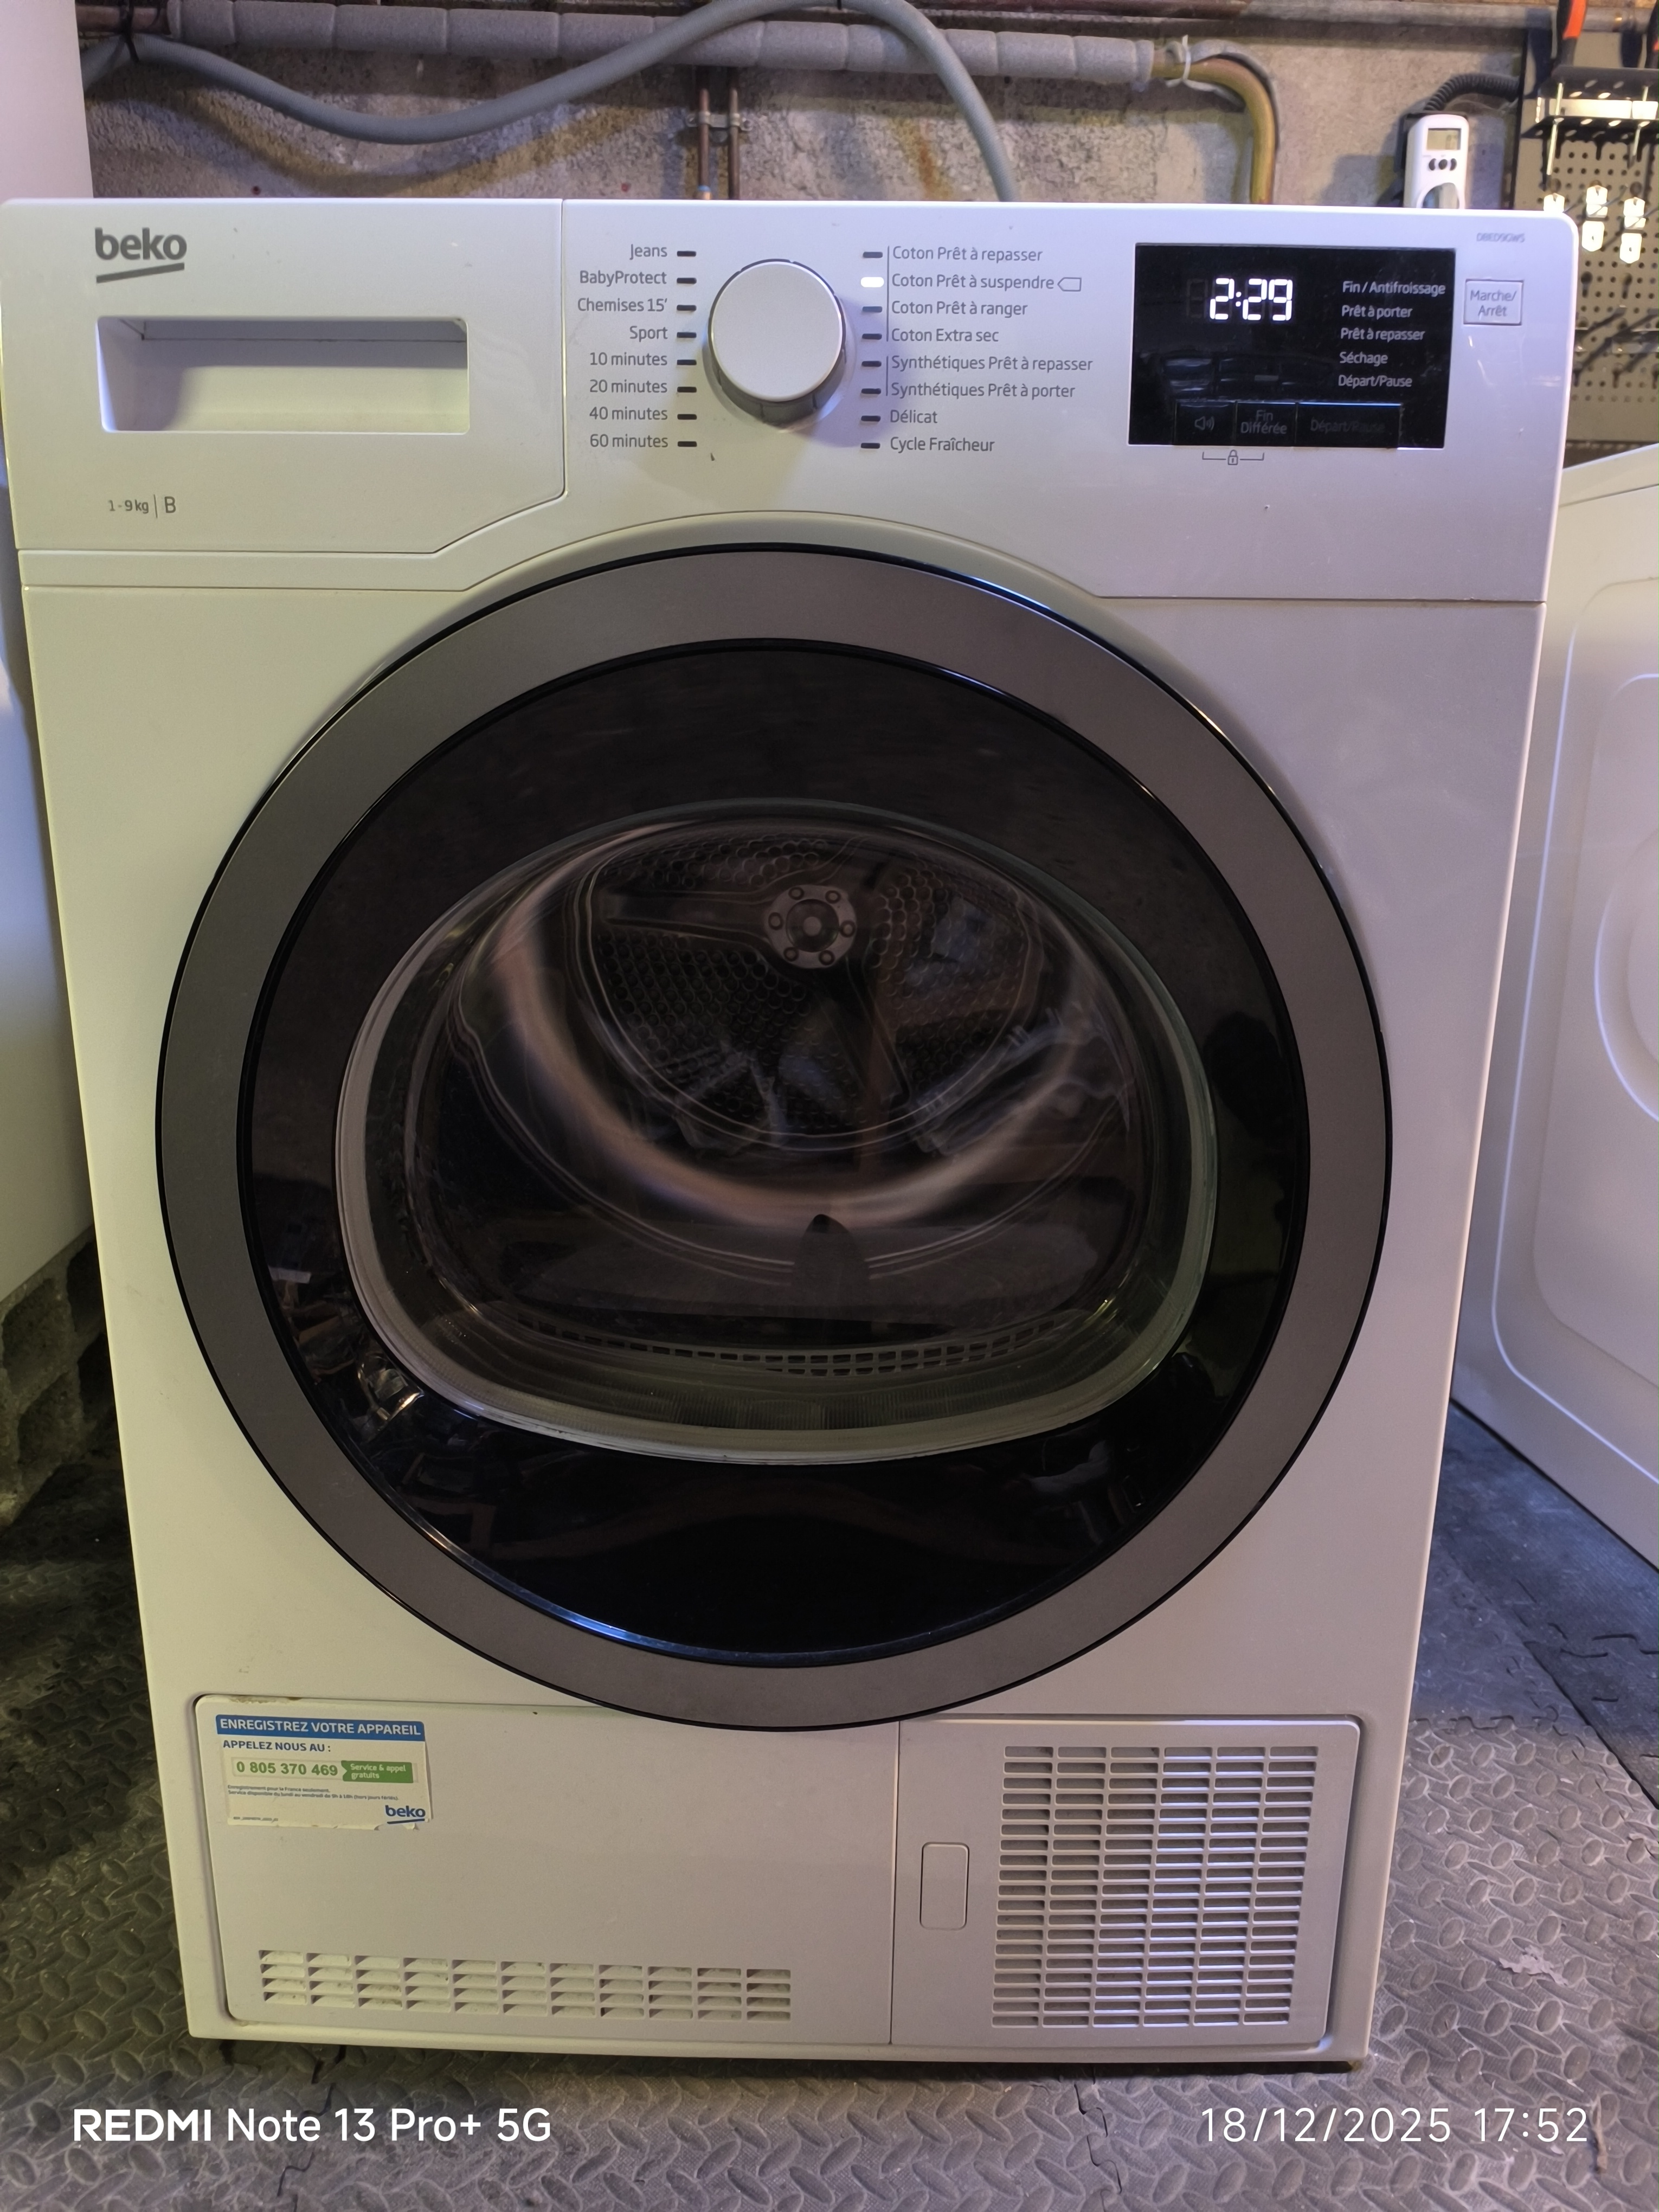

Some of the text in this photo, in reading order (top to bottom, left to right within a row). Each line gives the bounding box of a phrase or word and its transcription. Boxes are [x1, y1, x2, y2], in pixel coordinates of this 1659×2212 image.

[94, 227, 187, 260] beko
[629, 243, 667, 260] Jeans
[892, 246, 1043, 263] Coton Prêt à repasser
[580, 270, 667, 287] BabyProtect
[892, 273, 1054, 292] Coton Prêt à suspendre
[1342, 281, 1361, 294] Fin
[1370, 281, 1446, 297] Antifroissage
[1470, 290, 1517, 301] Marche/
[577, 297, 645, 312] Chemises
[1208, 278, 1293, 321] 2:29
[891, 300, 1028, 318] Coton Prêt à ranger
[1341, 304, 1413, 320] Prêt à porter
[1478, 304, 1507, 318] Arrêt
[629, 325, 668, 343] Sport
[891, 328, 999, 342] Coton Extra sec
[1340, 328, 1425, 343] Prêt à repasser
[590, 352, 668, 366] 10 minutes
[891, 355, 1093, 374] Synthétiques Prêt à repasser
[1339, 351, 1388, 366] Séchage
[589, 379, 668, 393] 20 minutes
[1339, 375, 1412, 389] Départ/Pause
[891, 382, 1076, 401] Synthétiques Prêt à porter
[589, 406, 668, 420] 40 minutes
[890, 409, 938, 423] Délicat
[1256, 409, 1274, 422] Fin
[1240, 422, 1288, 435] Différée
[590, 434, 668, 448] 60 minutes
[890, 436, 995, 454] Cycle Fraîcheur
[164, 496, 177, 514] B
[220, 1718, 421, 1735] ENREGISTREZ VOTRE APPAREIL
[223, 1740, 273, 1750] APPELEZ
[275, 1742, 306, 1751] NOUS
[310, 1743, 325, 1752] AU
[236, 1761, 338, 1776] 0 805 370 469
[350, 1763, 377, 1771] Service
[386, 1764, 406, 1773] appel
[351, 1771, 380, 1780] gratuits
[385, 1805, 426, 1817] beko
